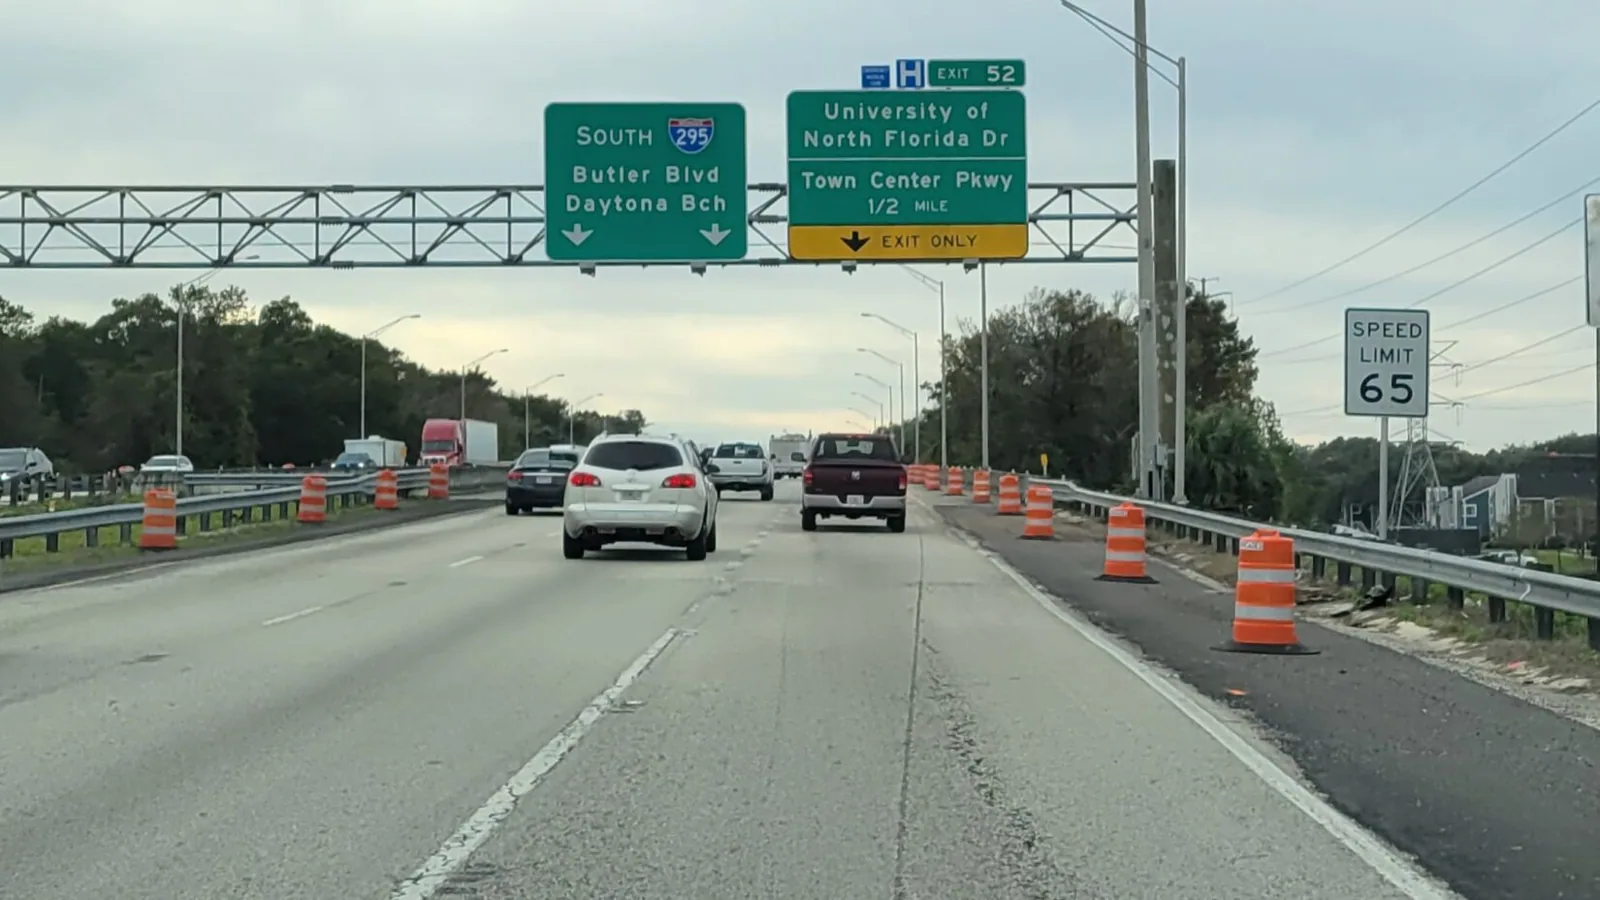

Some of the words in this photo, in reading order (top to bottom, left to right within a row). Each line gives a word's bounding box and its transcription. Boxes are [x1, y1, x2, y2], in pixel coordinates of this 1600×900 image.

[937, 68, 969, 80] EXIT
[987, 65, 1015, 82] 52
[824, 102, 952, 123] University
[967, 102, 989, 119] of
[576, 126, 653, 145] SOUTH
[676, 128, 709, 146] 295
[803, 130, 872, 147] North
[885, 130, 969, 147] Florida
[983, 130, 1009, 147] Dr
[573, 166, 650, 183] Butler
[666, 166, 719, 183] Blvd
[802, 172, 857, 189] Town
[870, 171, 941, 189] Center
[956, 171, 1013, 192] Pkwy
[566, 194, 668, 216] Daytona
[682, 194, 726, 212] Bch
[868, 198, 899, 215] 1/2
[915, 200, 948, 213] MILE
[882, 235, 920, 248] EXIT
[931, 235, 978, 248] ONLY
[1353, 321, 1422, 339] SPEED
[1360, 346, 1414, 364] LIMIT
[1360, 372, 1413, 404] 65
